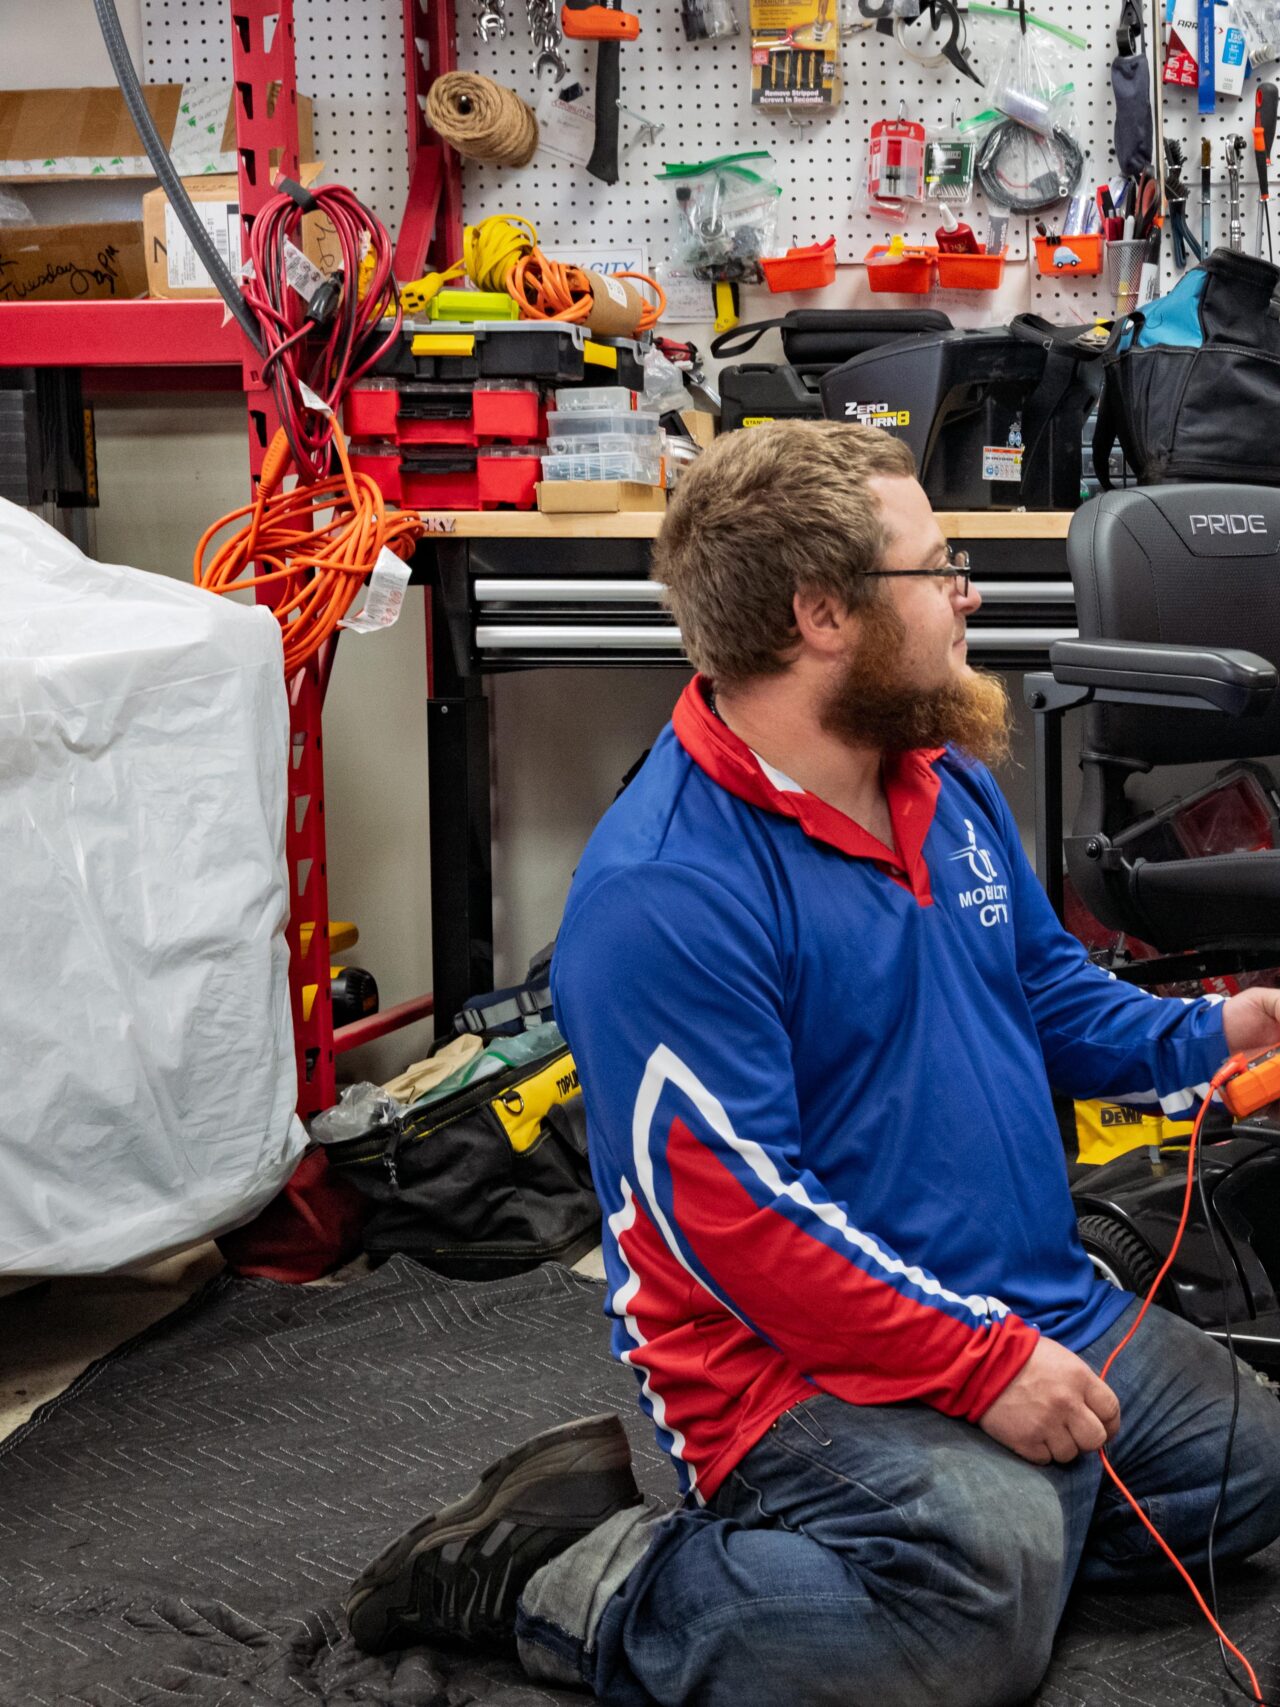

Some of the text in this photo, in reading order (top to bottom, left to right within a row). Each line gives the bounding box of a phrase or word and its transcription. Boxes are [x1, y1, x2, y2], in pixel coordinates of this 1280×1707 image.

[590, 261, 635, 275] CITY
[845, 401, 889, 415] ZERO
[422, 518, 457, 533] SKY
[1189, 514, 1268, 535] PRIDE
